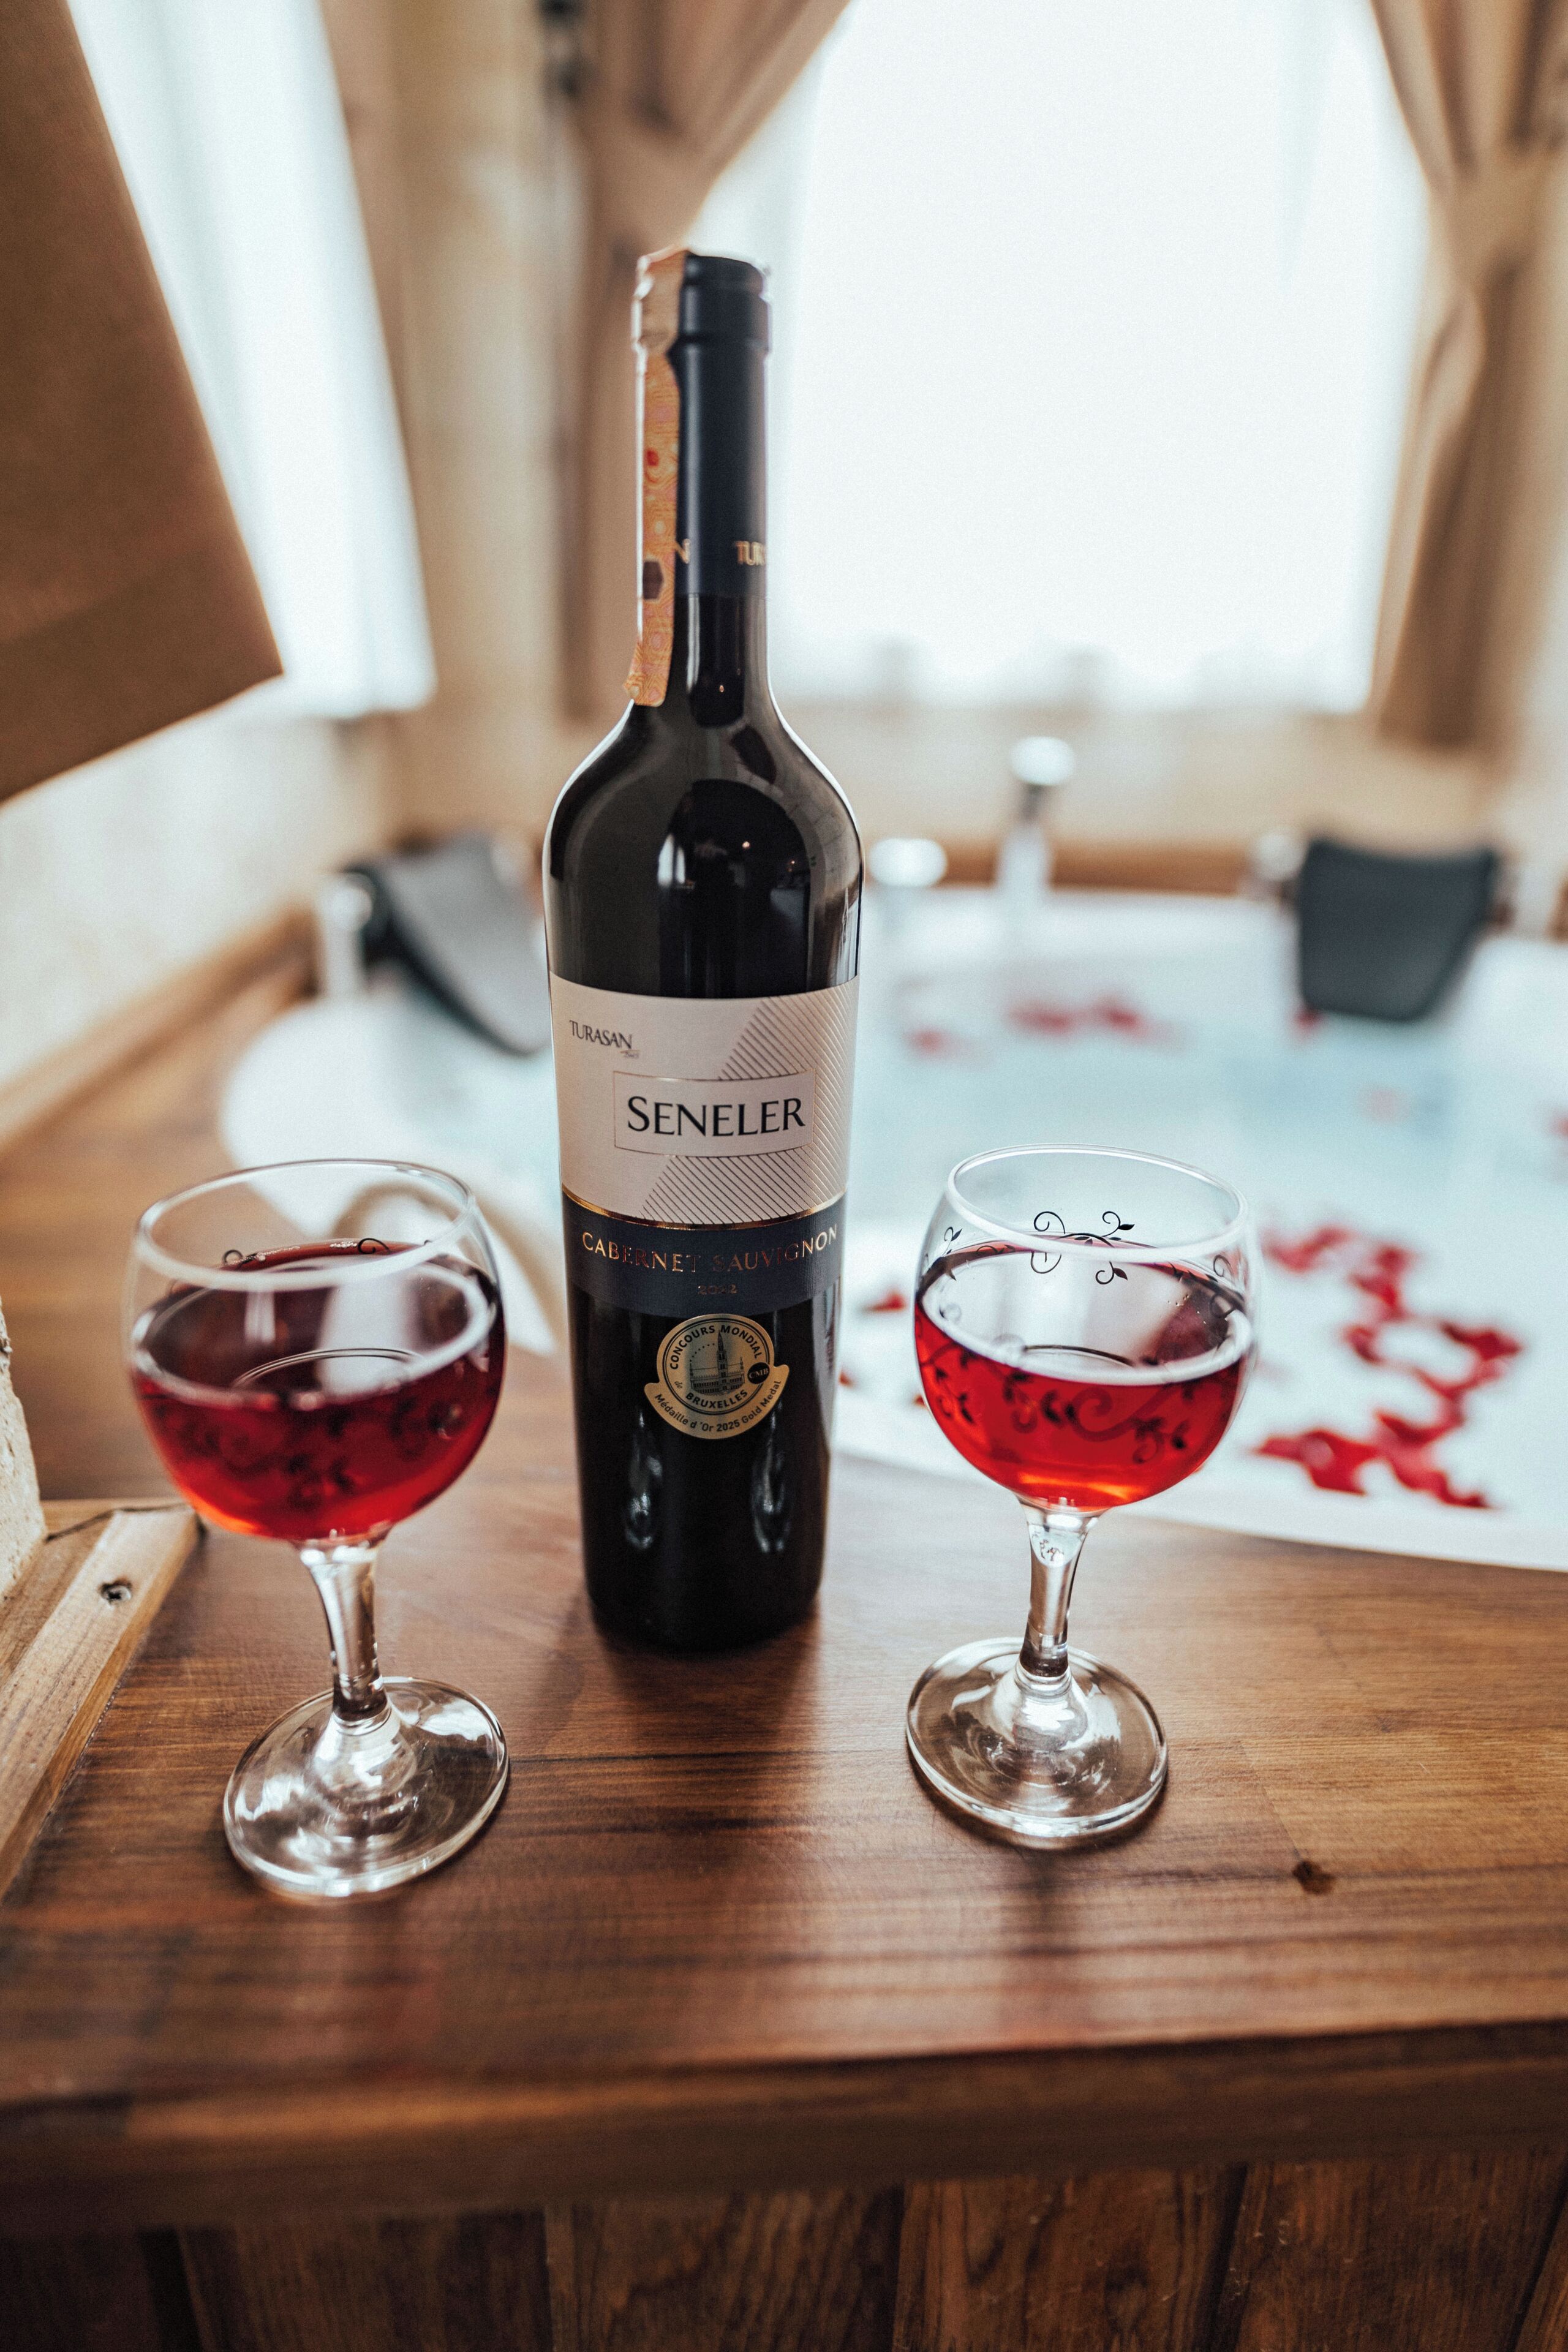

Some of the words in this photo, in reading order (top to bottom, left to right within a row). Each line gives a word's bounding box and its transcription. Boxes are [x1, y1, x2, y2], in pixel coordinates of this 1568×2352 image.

[569, 1020, 632, 1049] TURASAN
[627, 1096, 806, 1137] SENELER
[582, 1231, 701, 1273] CABERNET
[712, 1224, 837, 1272] SAUVIGNON
[669, 1325, 715, 1370] CONCOURS
[720, 1325, 762, 1359] MONDIAL
[749, 1368, 769, 1378] CMB
[655, 1393, 688, 1425] Médaille
[716, 1420, 740, 1432] 2025
[741, 1406, 762, 1423] Gold
[760, 1381, 781, 1407] Medal
[685, 1389, 748, 1409] BRUXELLES
